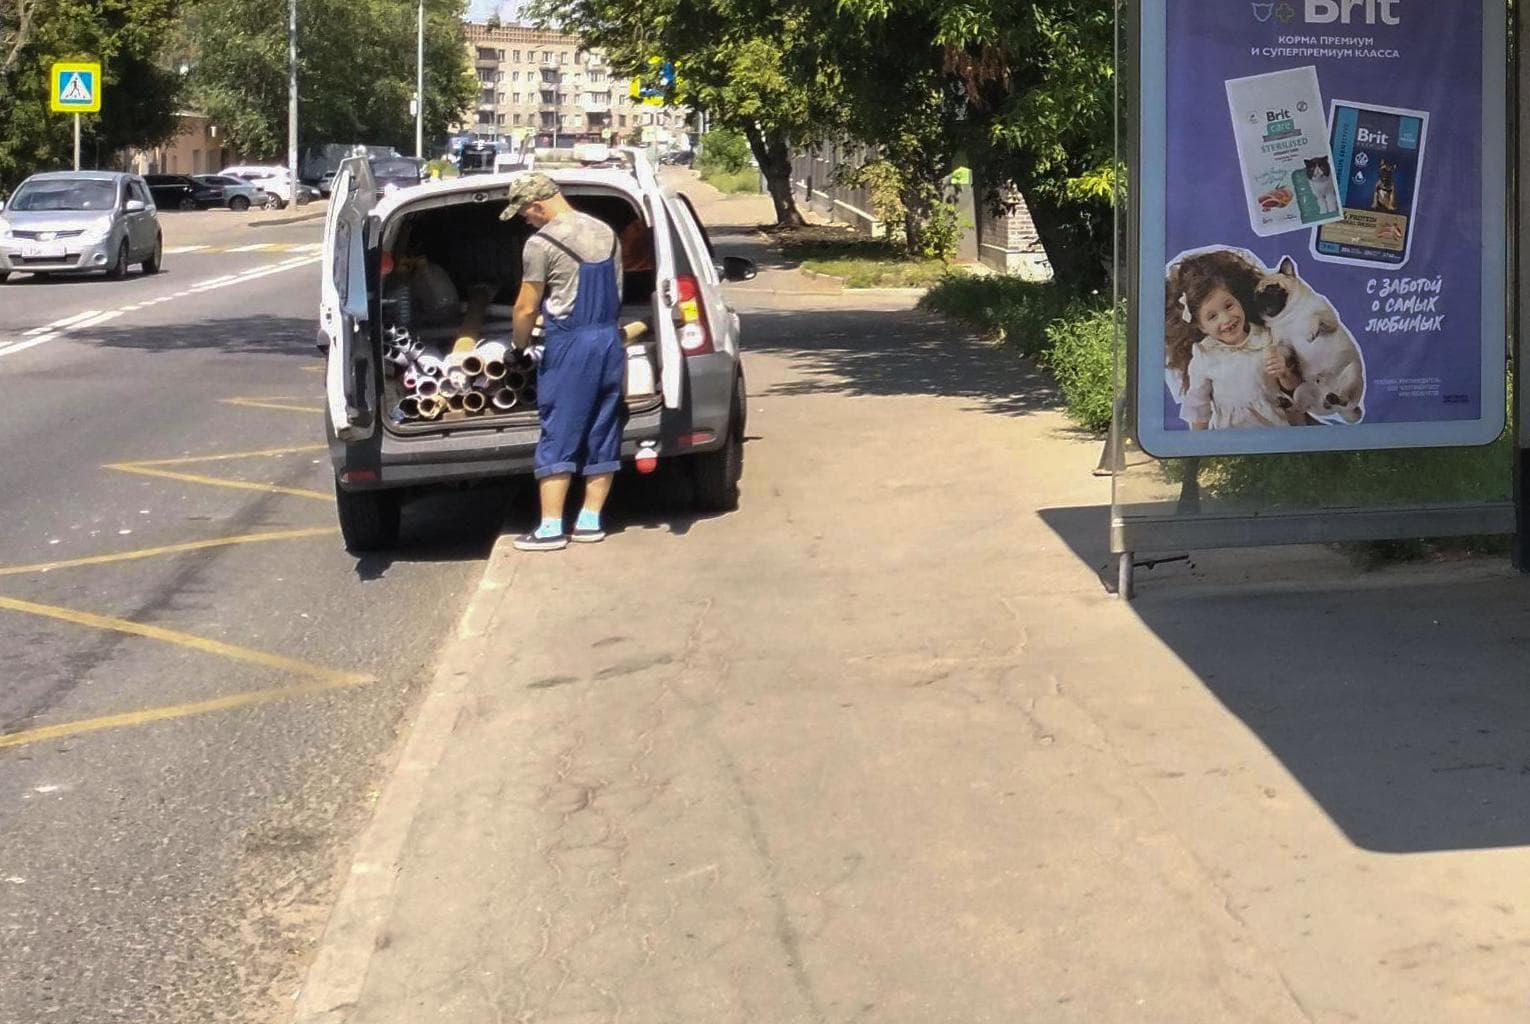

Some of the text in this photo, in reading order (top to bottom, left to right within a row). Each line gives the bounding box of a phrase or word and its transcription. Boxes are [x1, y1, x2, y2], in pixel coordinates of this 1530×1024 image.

[1278, 35, 1374, 47] КОРМА ПРЕМИУМ
[1251, 48, 1400, 58] И СУПЕРПРЕМИУМ КЛАССА
[1266, 109, 1291, 122] Brit
[1357, 127, 1389, 145] Brit
[1385, 295, 1440, 314] САМЫХ
[1365, 314, 1445, 334] ЛЮБИМЫХ
